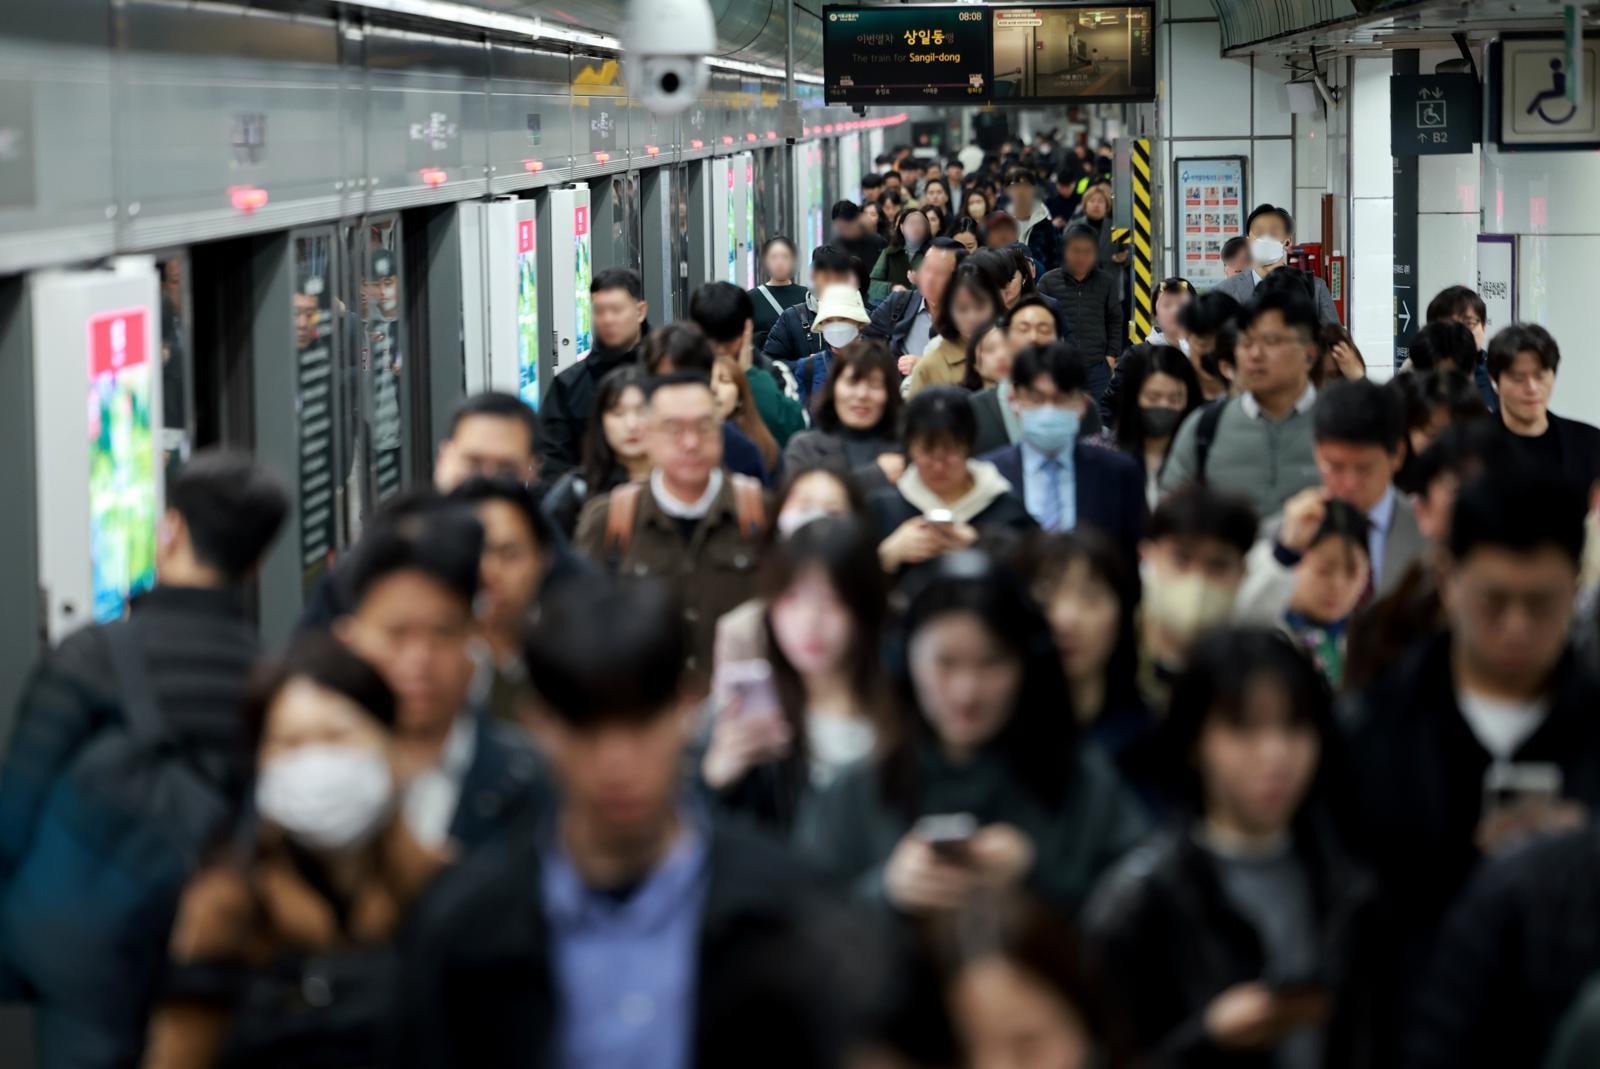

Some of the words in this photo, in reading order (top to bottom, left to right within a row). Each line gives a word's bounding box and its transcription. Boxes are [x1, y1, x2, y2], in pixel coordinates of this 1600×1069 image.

[958, 12, 982, 21] 08:08
[852, 54, 868, 63] The
[871, 54, 891, 63] train
[894, 53, 907, 62] for
[909, 52, 960, 63] Sangil-dong
[1432, 132, 1448, 143] B2
